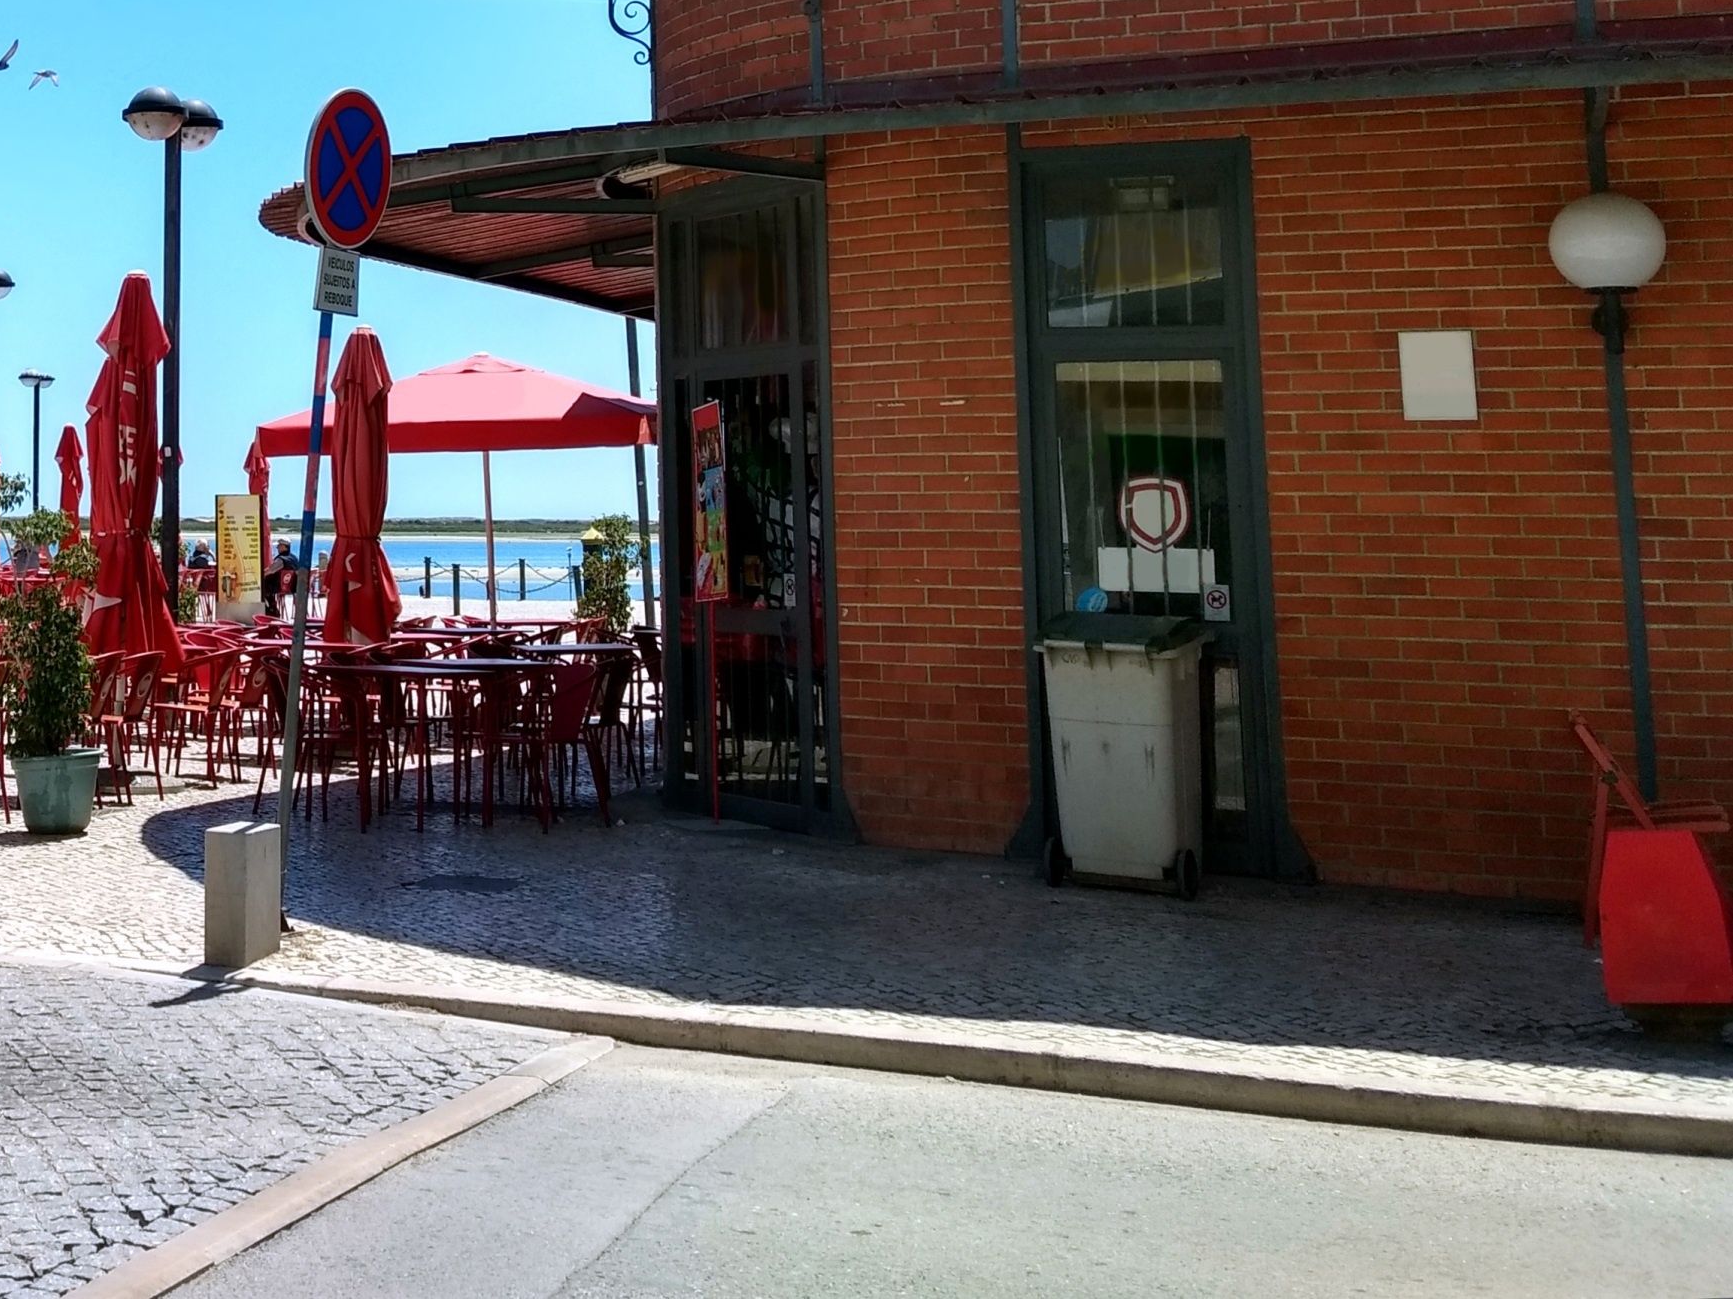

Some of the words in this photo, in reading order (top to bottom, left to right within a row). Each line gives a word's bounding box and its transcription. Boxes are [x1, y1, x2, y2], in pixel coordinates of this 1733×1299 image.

[323, 273, 350, 289] SUJEITOS
[352, 279, 356, 289] A
[323, 291, 353, 307] REBOQUE
